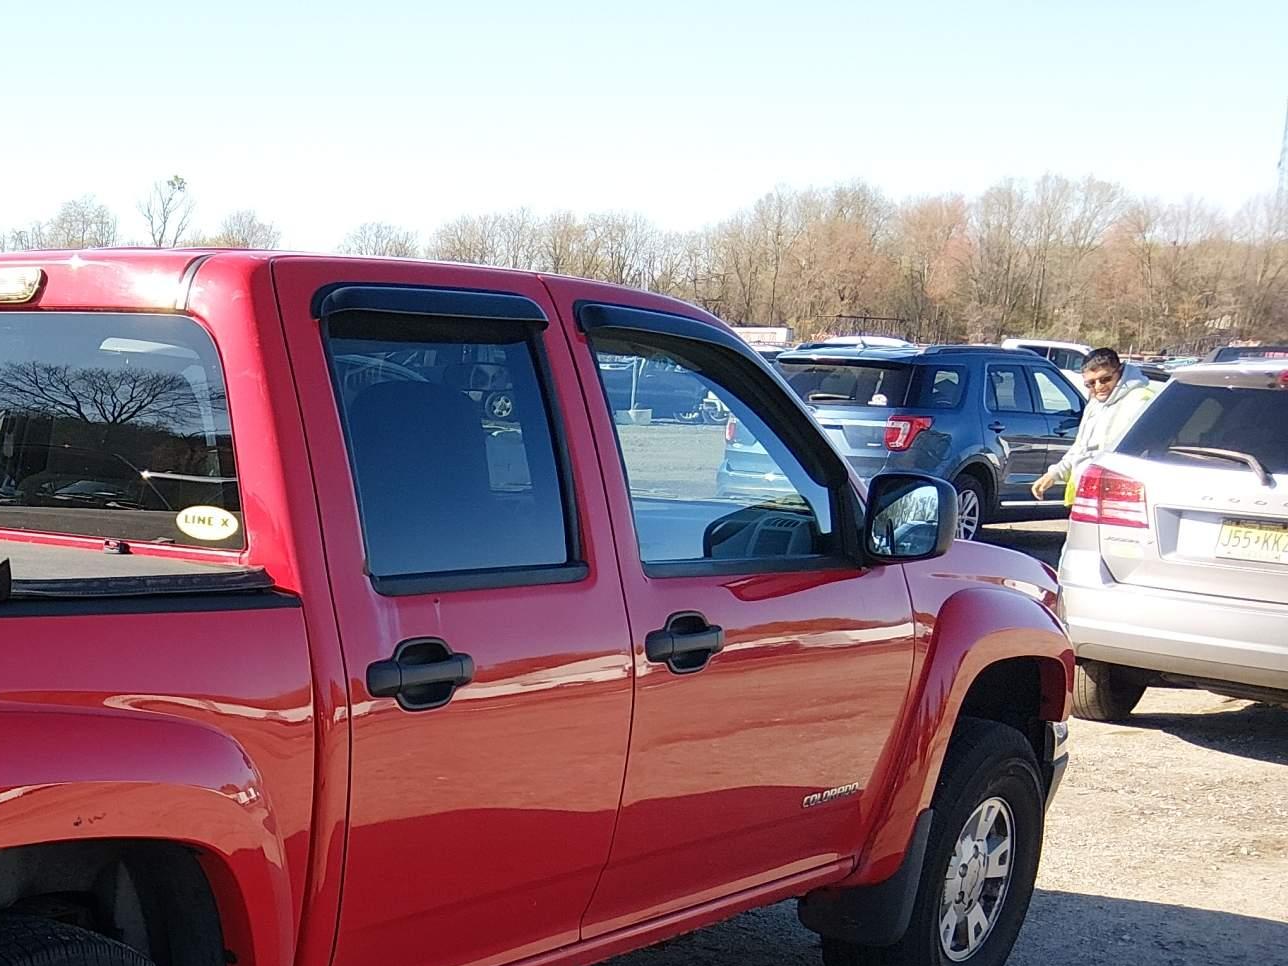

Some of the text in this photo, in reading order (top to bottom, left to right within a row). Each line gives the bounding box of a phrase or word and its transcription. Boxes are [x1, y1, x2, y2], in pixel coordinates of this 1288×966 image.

[184, 515, 229, 527] LINE X
[801, 781, 859, 808] COLORADO
